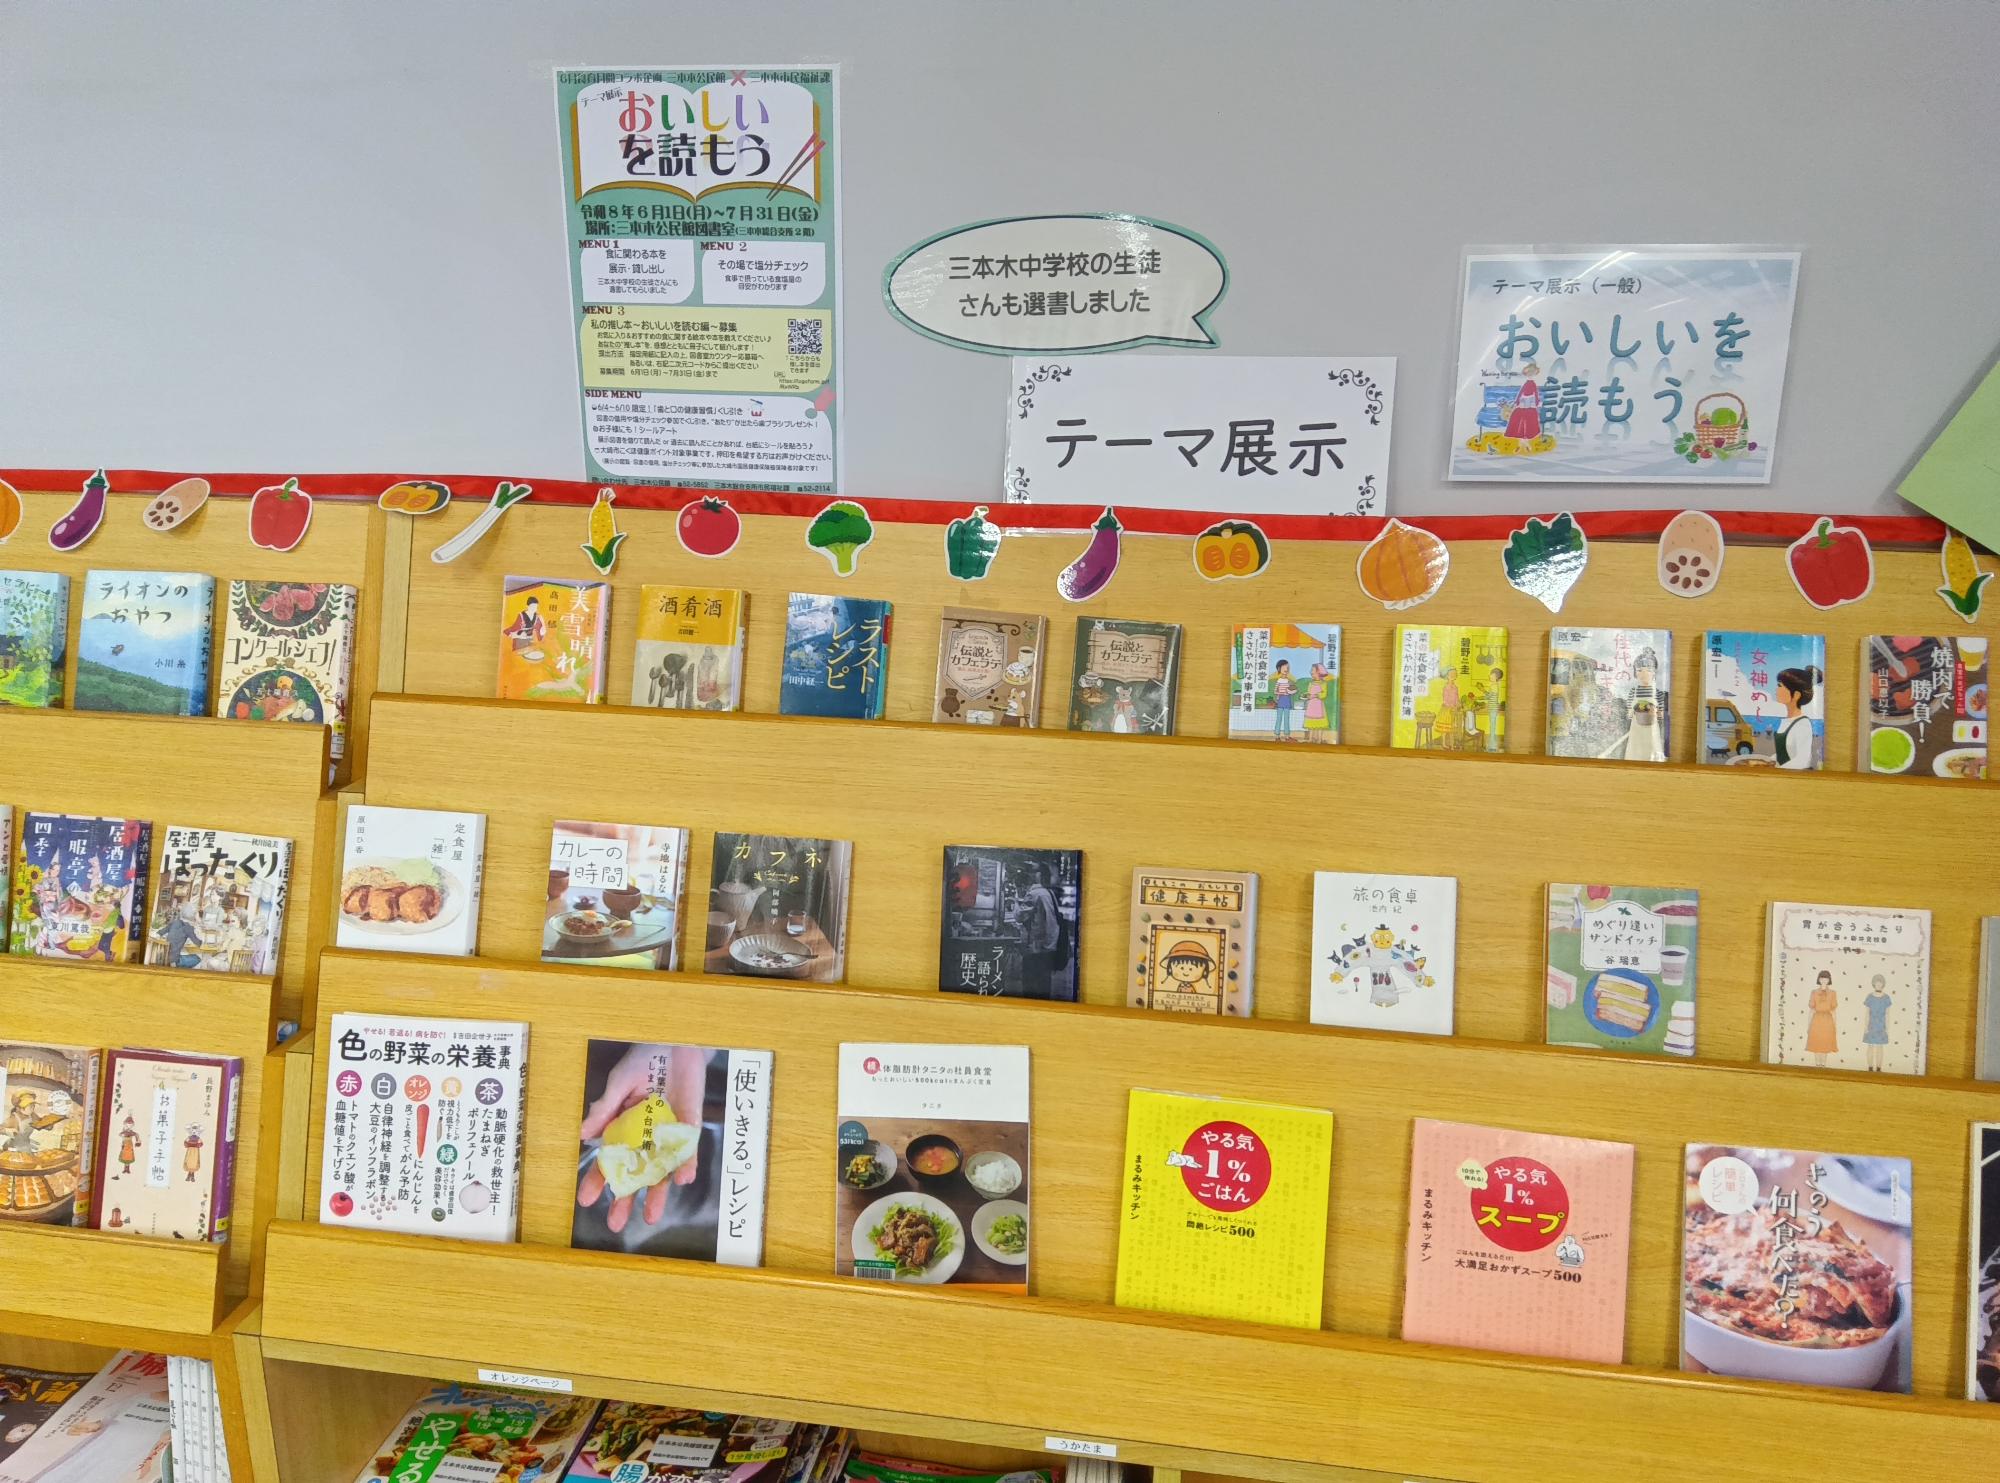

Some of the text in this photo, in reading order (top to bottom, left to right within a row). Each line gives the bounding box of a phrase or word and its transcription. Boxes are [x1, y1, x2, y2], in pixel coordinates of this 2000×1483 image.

[581, 87, 623, 107] テーマ展示
[618, 90, 770, 132] おいしい
[619, 133, 771, 177] を読もう
[578, 240, 620, 250] MENU 1
[606, 249, 667, 260] 食に関わる本を
[700, 241, 748, 252] MENU 2
[718, 260, 809, 272] その場で塩分チェック
[948, 249, 1162, 281] 三本木中学校の生徒
[1492, 277, 1643, 296] テーマ展示（一般）
[582, 305, 625, 316] MENU 3
[959, 288, 1151, 318] さんも選書しました
[1496, 312, 1751, 359] おいしいを
[585, 389, 642, 399] SIDE MENU
[1540, 375, 1684, 425] 読もう
[1045, 418, 1348, 478] テーマ展示
[99, 582, 188, 599] ライオンの
[111, 607, 172, 625] おやつ
[660, 595, 723, 619] 酒肴酒
[556, 585, 593, 673] 美雪晴れ
[226, 637, 337, 676] コンクールシェフ!
[826, 621, 857, 689] レシピ
[853, 618, 882, 694] ラスト
[951, 655, 1002, 669] カフェラテ
[960, 645, 994, 658] 伝説と
[1101, 650, 1152, 664] カフェラテ
[1110, 640, 1144, 653] 伝説と
[1258, 630, 1269, 690] 菜の花食堂の
[1711, 634, 1722, 678] 原宏一
[1243, 631, 1255, 713] ささやかな事件簿
[1402, 632, 1413, 716] ささやかな事件簿
[1417, 632, 1428, 694] 菜の花食堂の
[1930, 647, 1955, 710] 焼肉で
[1750, 648, 1769, 723] 女神めし
[1911, 679, 1932, 743] 勝負!
[34, 822, 52, 857] 四季
[168, 830, 216, 849] 居酒屋
[354, 815, 366, 854] 原田ひ香
[451, 823, 466, 861] 定食屋
[558, 839, 623, 860] カレーの
[105, 825, 126, 881] 居酒屋
[164, 847, 278, 880] ぼったくり
[659, 842, 671, 894] 寺地はるな
[734, 841, 822, 868] カフネ
[574, 861, 624, 888] 時間
[1153, 880, 1187, 888] ももこの
[1150, 889, 1229, 908] 健康手帖
[1353, 886, 1418, 904] 旅の食卓
[1589, 934, 1657, 946] サンドイッチ
[1592, 919, 1655, 932] めぐり逢い
[1802, 919, 1903, 934] 胃が合うふたり
[960, 952, 977, 987] 歴史
[339, 1075, 358, 1093] 赤
[376, 1077, 391, 1096] 白
[480, 1082, 499, 1101] 茶
[655, 1055, 668, 1108] 有元葉子の
[151, 1094, 170, 1182] お菓子手帖
[333, 1099, 347, 1181] 血糖値を下げる
[344, 1099, 358, 1192] トマトのクエン酸が
[462, 1107, 479, 1181] ポリフェノール
[480, 1108, 493, 1157] たまねぎ
[1201, 1130, 1255, 1152] やる気
[366, 1102, 381, 1200] 大豆のイソフラボン
[379, 1103, 393, 1201] 自律神経を調整する
[440, 1146, 455, 1162] 緑
[1205, 1150, 1251, 1183] 1%
[411, 1159, 424, 1214] にんじんを
[1130, 1154, 1143, 1221] まるみキッチン
[1494, 1166, 1548, 1186] やる気
[1197, 1183, 1251, 1204] ごはん
[1503, 1183, 1535, 1206] 1%
[1804, 1163, 1828, 1237] きのう
[1421, 1189, 1433, 1263] まるみキッチン
[1477, 1205, 1566, 1235] スープ
[1769, 1184, 1805, 1330] 何食べた?
[491, 1373, 560, 1388] オレンジページ
[1059, 1440, 1102, 1454] うかたま
